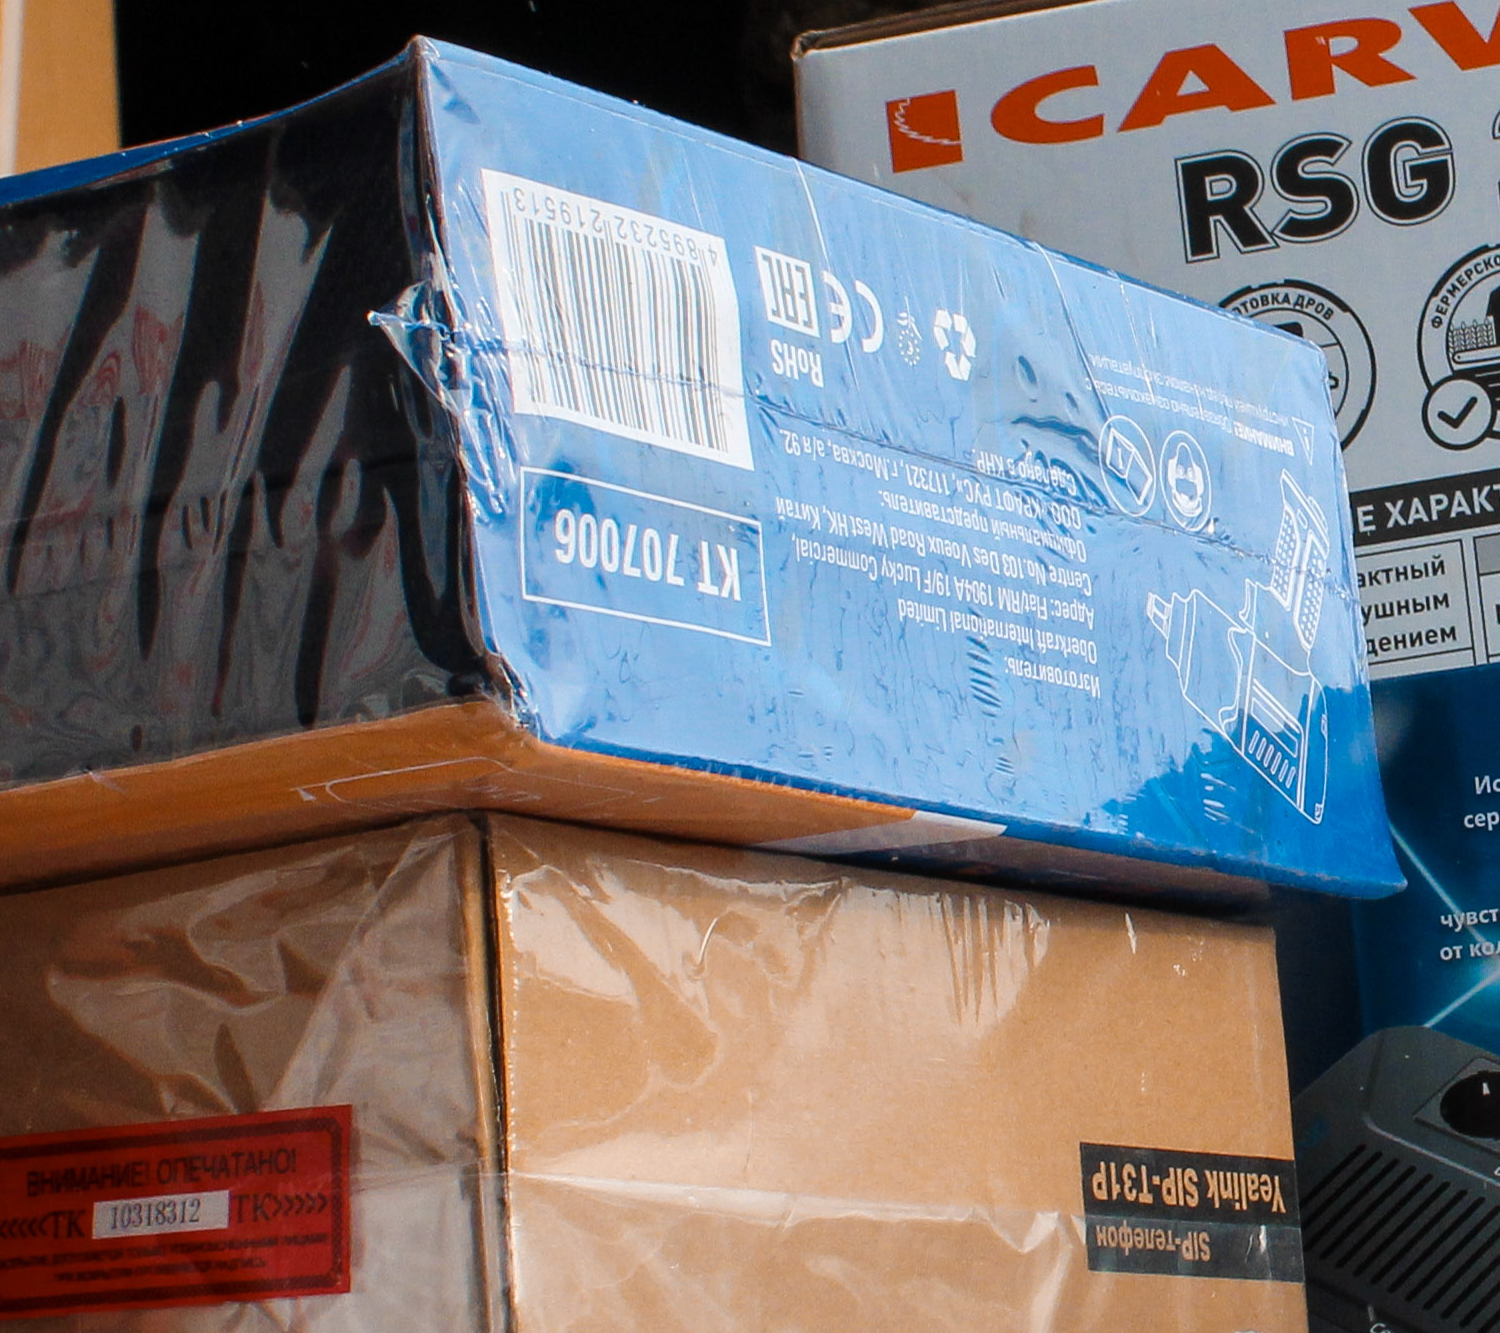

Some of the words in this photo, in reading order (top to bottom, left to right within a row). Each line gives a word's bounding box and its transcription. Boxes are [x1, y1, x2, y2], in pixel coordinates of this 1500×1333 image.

[1175, 116, 1455, 261] RSG
[1293, 293, 1334, 320] ДРОВ
[770, 336, 824, 388] RoHS
[1233, 420, 1295, 457] ВНИМАНИЕ!
[879, 491, 989, 532] представитель:
[555, 508, 685, 587] 707006
[792, 534, 878, 581] Commercial,
[898, 598, 947, 632] Limited
[951, 612, 1034, 649] International
[1050, 599, 1094, 630] Адрес:
[1037, 636, 1097, 665] Oberkraft
[1005, 655, 1101, 698] Изготовитель:
[1439, 945, 1462, 961] от
[157, 1149, 297, 1185] ОПЕЧАТАНО!
[1091, 1161, 1199, 1208] SIP-T31P
[1205, 1170, 1286, 1213] Yealink
[110, 1198, 200, 1231] 10318312
[1096, 1219, 1211, 1262] SIP-телефон
